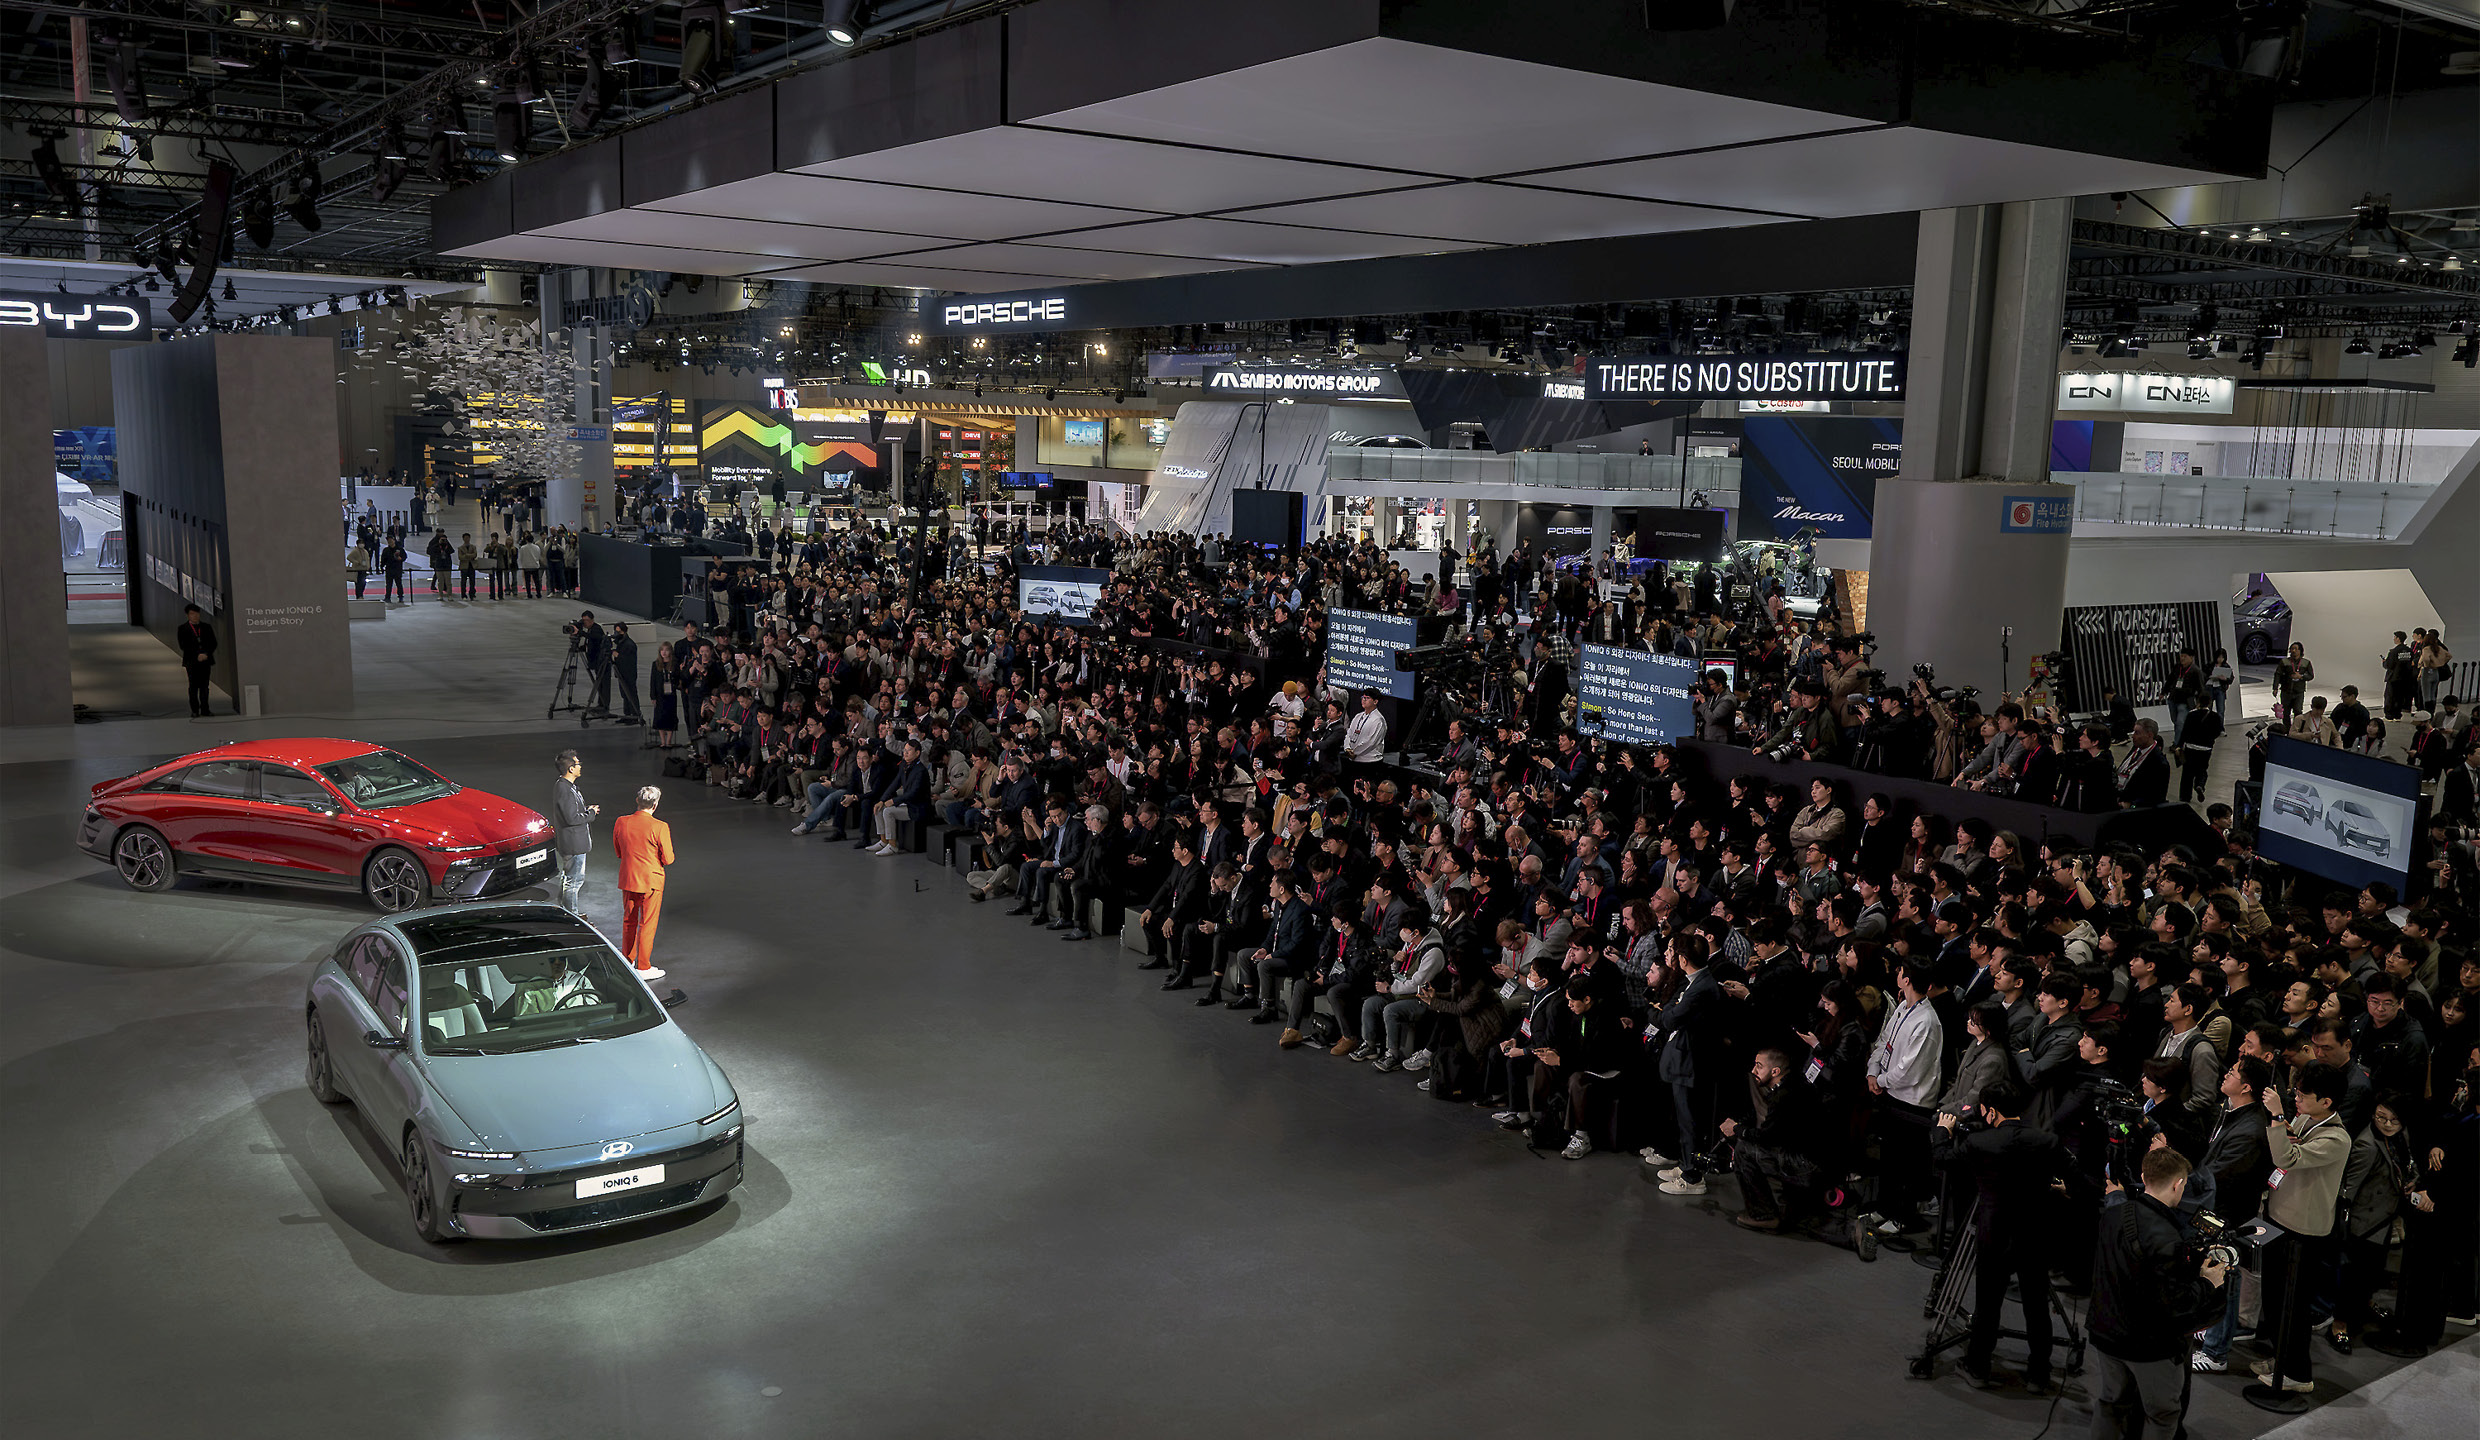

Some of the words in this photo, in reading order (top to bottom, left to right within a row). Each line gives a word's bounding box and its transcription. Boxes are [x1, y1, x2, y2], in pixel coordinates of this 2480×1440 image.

[0, 301, 140, 331] BYD
[946, 298, 1065, 326] PORSCHE
[1284, 374, 1335, 391] MOTORS
[1336, 375, 1381, 391] GROUP
[1599, 363, 1667, 392] THERE
[1671, 363, 1692, 392] IS
[1698, 363, 1732, 392] NO
[1737, 361, 1899, 392] SUBSTITUTE.
[1832, 456, 1864, 469] SEOUL
[1865, 457, 1902, 470] MOBILI
[1773, 505, 1845, 522] Macan
[1547, 527, 1592, 535] PORSC
[246, 607, 264, 616] The
[286, 606, 314, 614] IONIQ
[315, 605, 322, 613] 6
[246, 617, 279, 627] Design
[280, 617, 304, 626] Story
[1585, 644, 1605, 654] IONIQ
[1612, 648, 1624, 659] 외장
[1625, 650, 1650, 662] 디자이너
[1330, 666, 1344, 676] Today
[1583, 661, 1596, 671] 오늘
[1598, 663, 1604, 672] 이
[1629, 681, 1649, 691] IONIQ
[1581, 701, 1602, 713] Simon
[1607, 706, 1617, 715] So
[1617, 708, 1635, 720] Hong
[1609, 719, 1626, 729] more
[1628, 723, 1643, 733] than
[1644, 725, 1658, 736] just
[1659, 729, 1664, 737] a
[1618, 733, 1625, 741] of
[603, 1176, 631, 1189] IONIQ
[632, 1175, 639, 1183] 6
